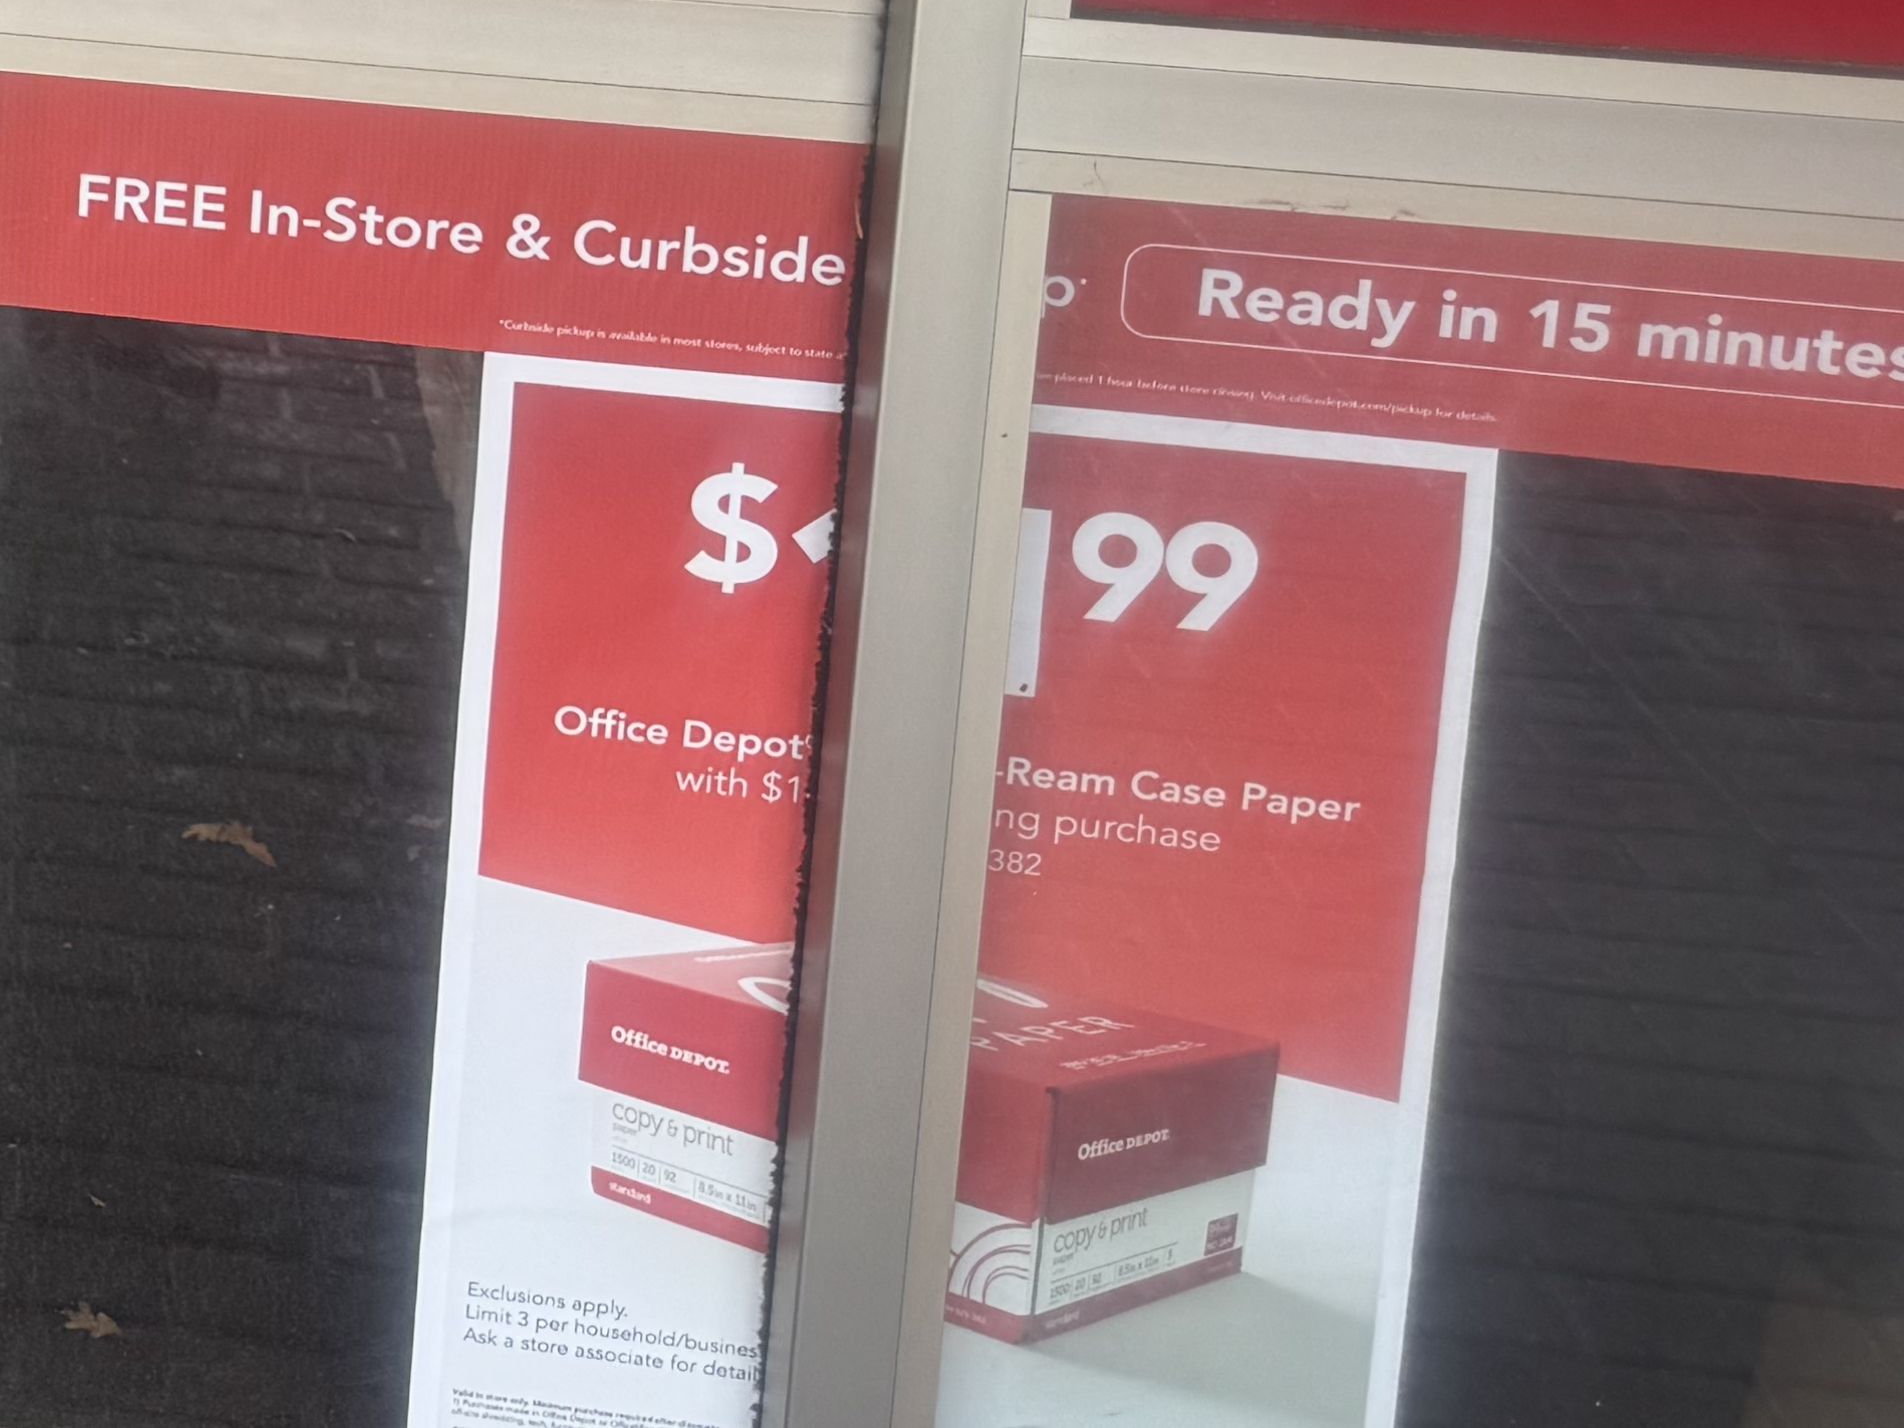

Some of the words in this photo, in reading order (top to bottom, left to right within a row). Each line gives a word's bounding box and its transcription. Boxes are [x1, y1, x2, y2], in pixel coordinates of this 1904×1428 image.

[77, 172, 228, 231] FREE
[248, 188, 484, 255] In-Store
[505, 212, 551, 262] &
[572, 219, 847, 288] Curbside
[1197, 265, 1416, 348] Ready
[1438, 288, 1500, 343] in
[1527, 297, 1613, 353] 15
[1636, 311, 1904, 384] minutes
[673, 335, 703, 348] most
[745, 342, 787, 357] subject
[804, 348, 834, 360] state
[553, 703, 670, 747] Office
[675, 765, 749, 799] with
[1130, 770, 1227, 808] Case
[1241, 781, 1362, 825] Paper
[993, 807, 1041, 841] ng
[1053, 815, 1222, 853] purchase
[987, 848, 1043, 877] 382
[610, 1025, 668, 1057] Office
[612, 1102, 665, 1137] copy
[683, 1123, 735, 1157] print
[1077, 1138, 1124, 1161] Office
[1125, 1128, 1170, 1150] DEPOT
[611, 1150, 637, 1171] 1500
[608, 1181, 652, 1205] standard
[1053, 1222, 1096, 1260] copy
[1109, 1206, 1149, 1240] print
[467, 1280, 566, 1310] Exclusions
[571, 1298, 629, 1321] apply.
[462, 1327, 498, 1346] Ask
[503, 1334, 514, 1348] a
[520, 1335, 569, 1356] store
[575, 1343, 665, 1370] associate
[671, 1353, 698, 1374] for
[465, 1302, 513, 1326] Limit
[517, 1310, 530, 1328] 3
[535, 1316, 569, 1334] per
[574, 1318, 760, 1360] household/busines
